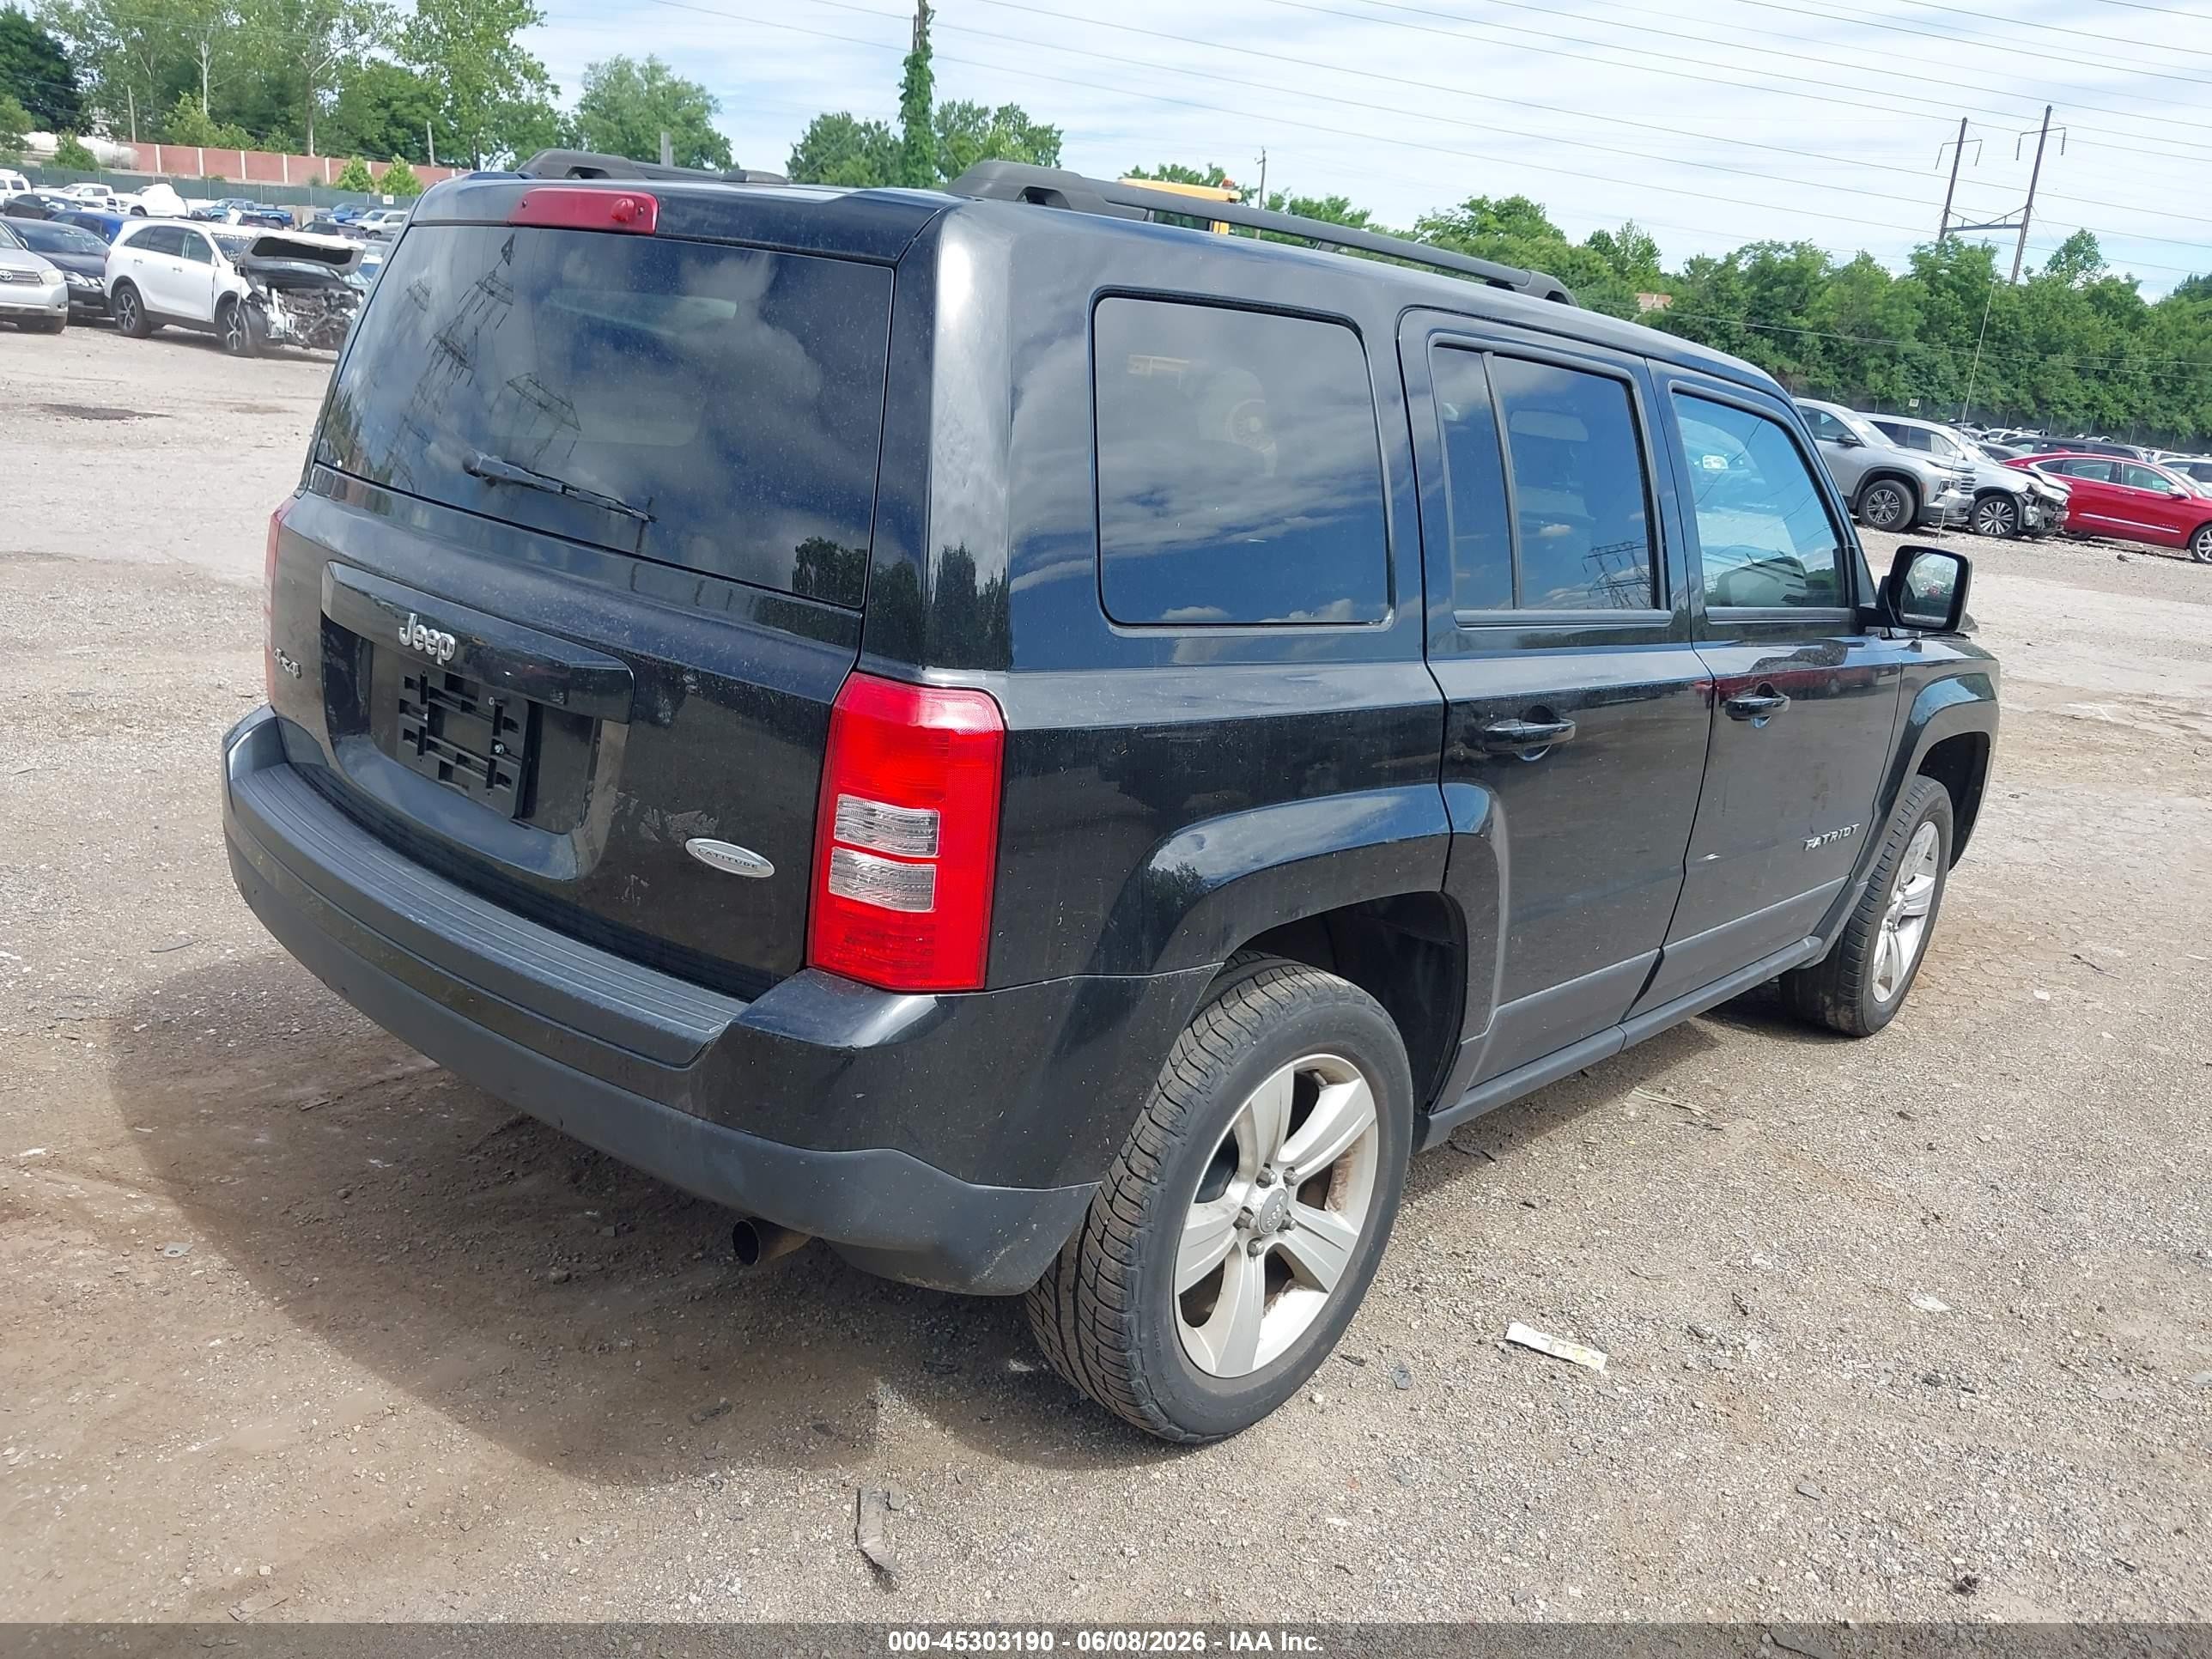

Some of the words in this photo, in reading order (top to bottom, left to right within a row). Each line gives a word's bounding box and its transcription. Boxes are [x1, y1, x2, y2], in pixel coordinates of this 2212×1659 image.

[398, 612, 456, 666] Jeep
[1804, 823, 1860, 852] PATRIOT
[696, 848, 758, 868] LATITUDE
